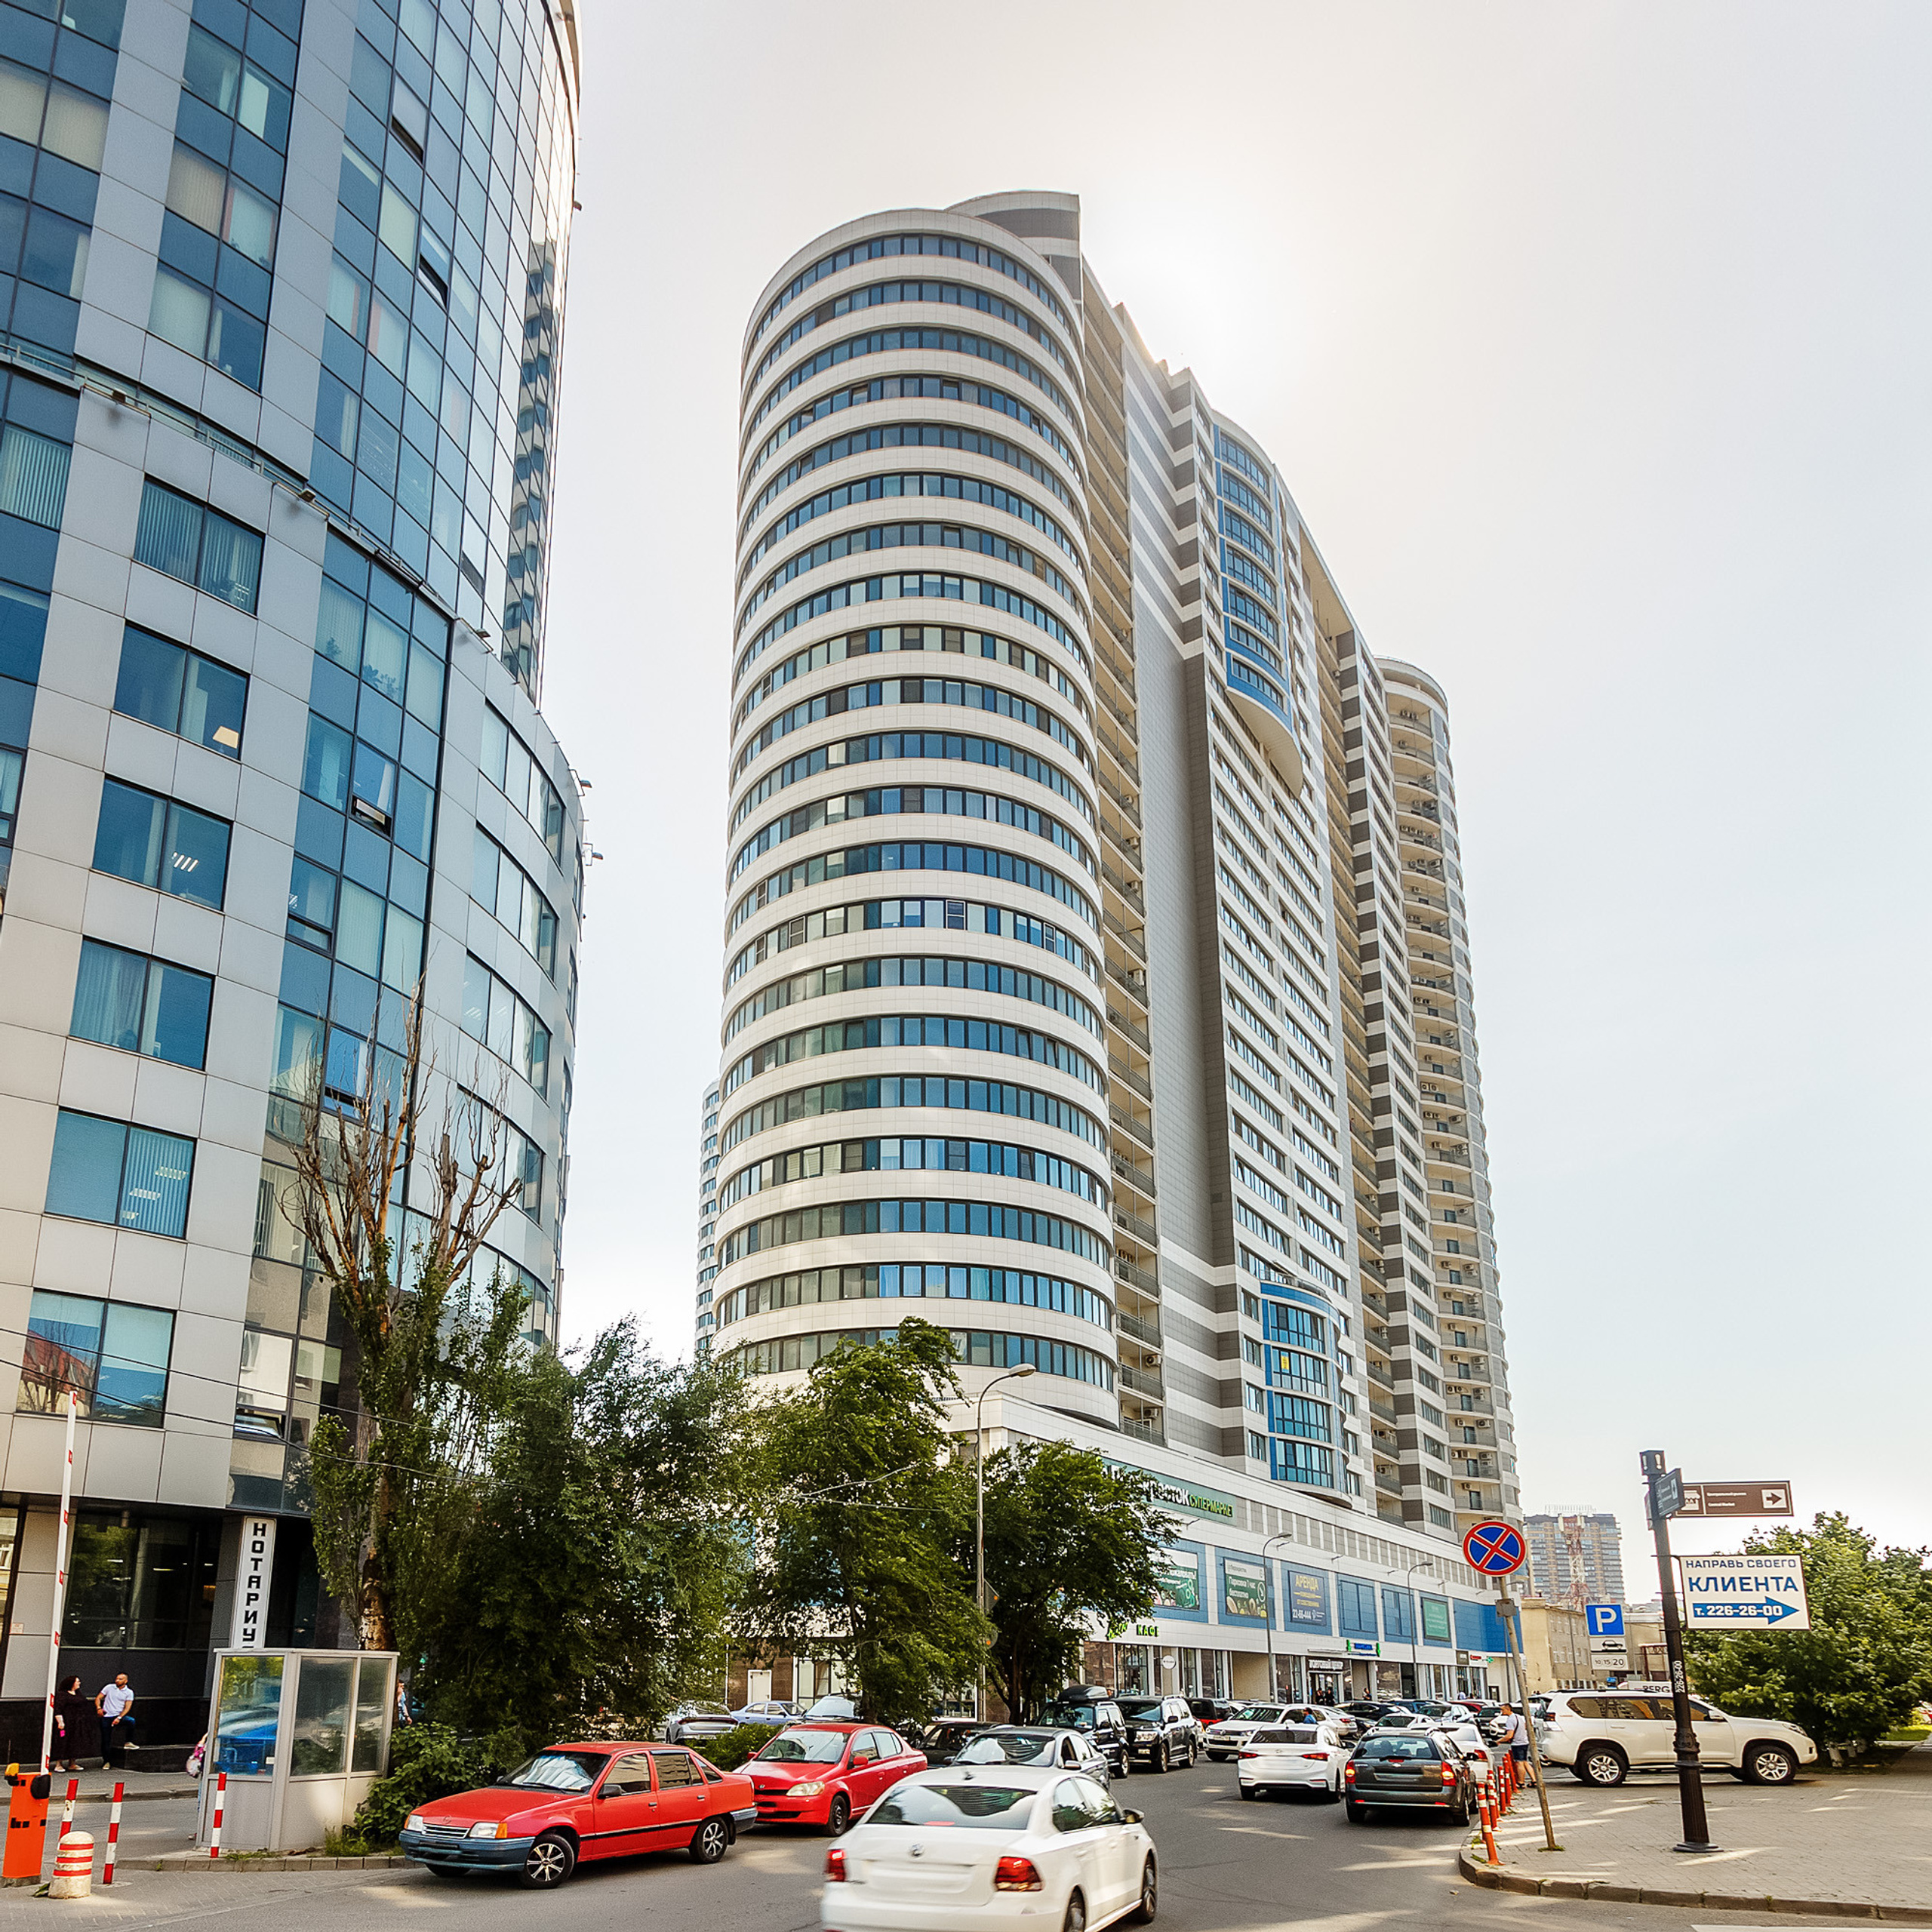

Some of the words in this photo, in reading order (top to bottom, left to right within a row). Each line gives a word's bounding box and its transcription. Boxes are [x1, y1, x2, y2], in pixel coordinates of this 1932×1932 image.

[1189, 1494, 1234, 1518] СУПЕРМАРКЕТ
[1686, 1560, 1743, 1568] НАПРАВЬ
[1747, 1559, 1796, 1567] СВОЕГО
[242, 1522, 267, 1648] НОТАРИУ
[1296, 1575, 1319, 1592] АРЕНДА
[1688, 1577, 1798, 1592] КЛИЕНТА
[1595, 1607, 1617, 1632] P
[1706, 1605, 1783, 1617] 226-26-00
[1137, 1624, 1159, 1637] КАФЕ
[1675, 1660, 1685, 1693] 226-26-00
